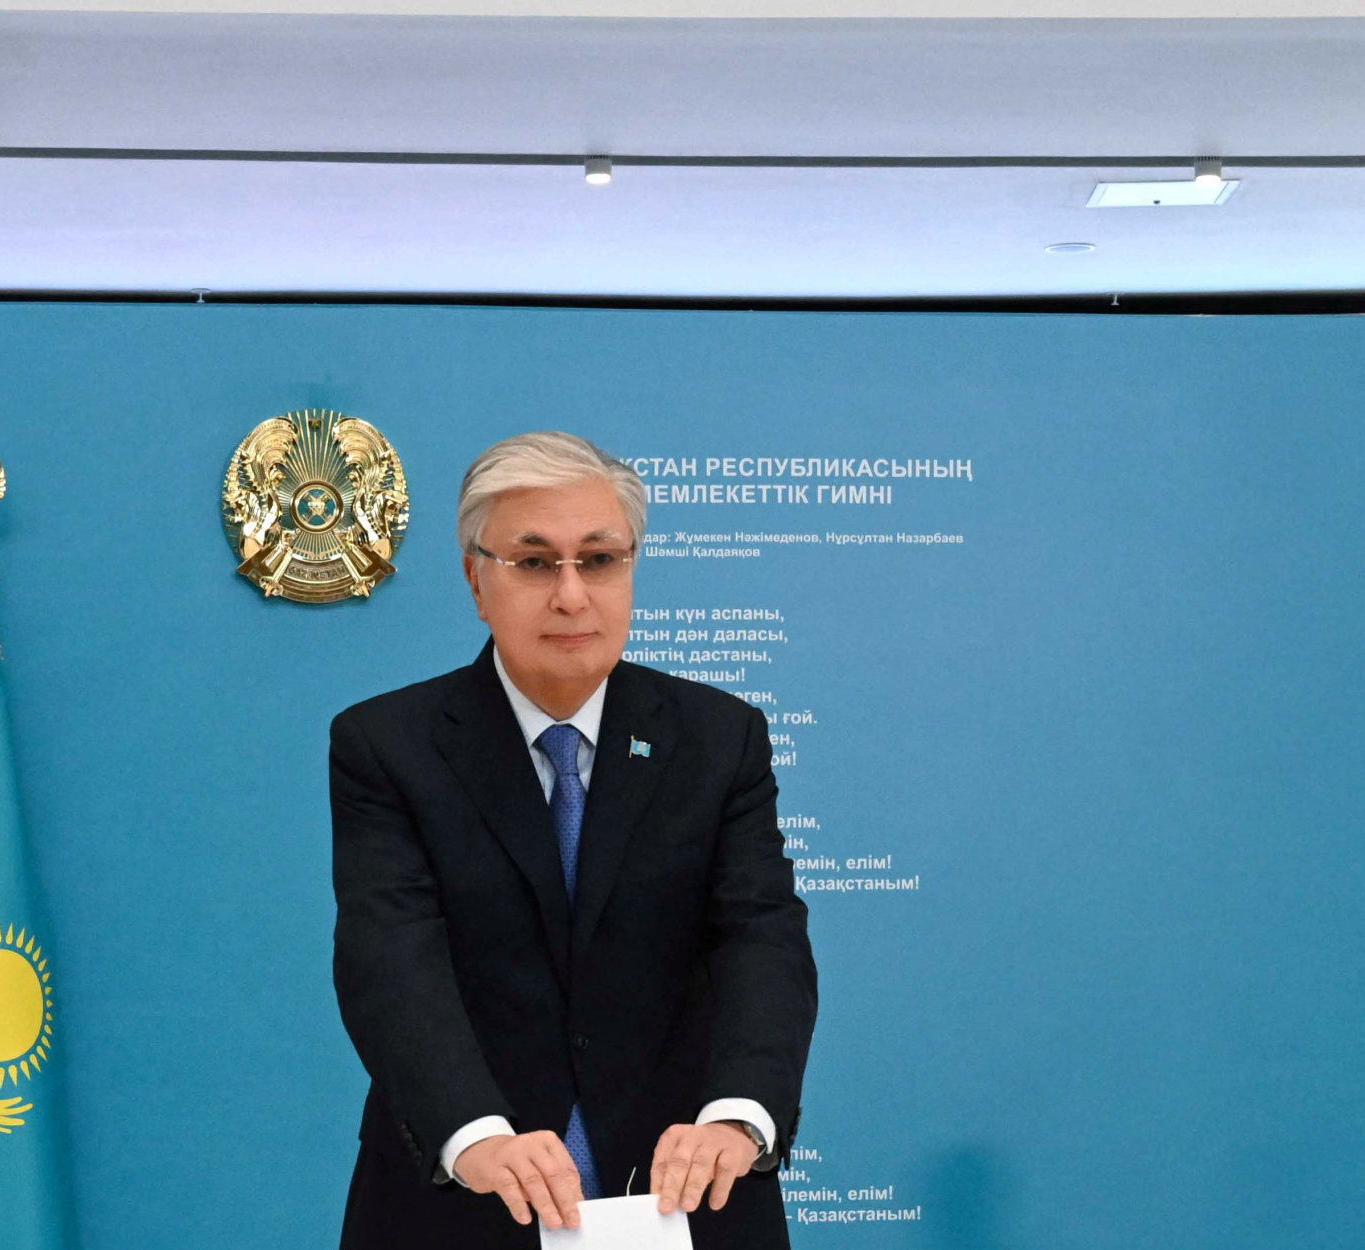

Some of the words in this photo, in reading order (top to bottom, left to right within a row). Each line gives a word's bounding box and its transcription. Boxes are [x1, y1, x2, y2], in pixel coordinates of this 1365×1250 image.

[706, 457, 973, 482] РЕСПУБЛИКАСЫНЫҢ
[817, 485, 892, 504] ГИМНІ
[826, 532, 893, 545] Нұрсұлтан
[896, 532, 964, 545] Назарбаев
[645, 546, 689, 557] Шәмші
[692, 546, 761, 559] Қалдаяқов
[675, 609, 706, 624] күн
[711, 608, 784, 622] аспаны,
[674, 630, 708, 643] дән
[713, 629, 788, 643] даласы,
[688, 650, 772, 664] дастаны,
[782, 710, 817, 725] ғой.
[777, 814, 821, 830] елім,
[793, 855, 841, 872] емін,
[845, 854, 891, 870] елім!
[795, 875, 920, 894] Қазақстаным!
[847, 1185, 893, 1201] елім!
[797, 1206, 921, 1225] Қазақстаным!
